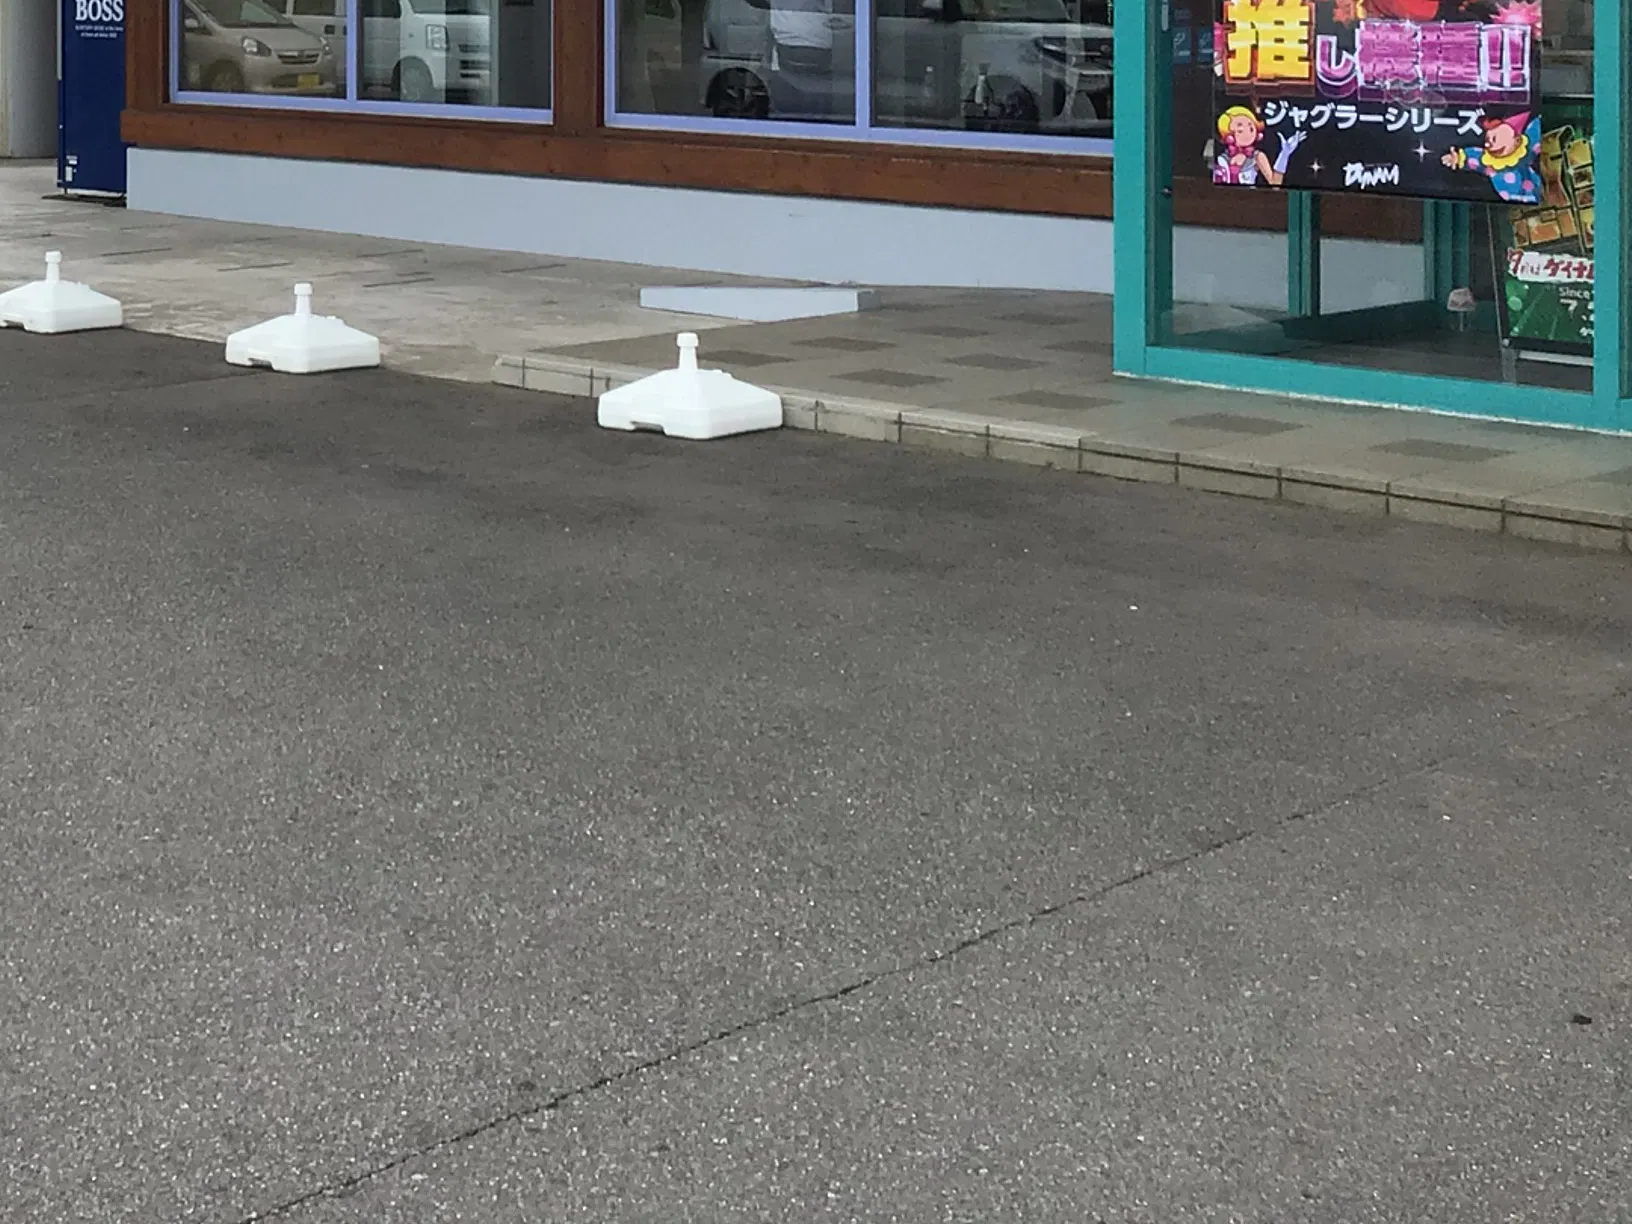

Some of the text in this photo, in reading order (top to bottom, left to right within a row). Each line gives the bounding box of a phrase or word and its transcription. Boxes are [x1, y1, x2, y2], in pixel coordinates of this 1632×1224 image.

[1264, 100, 1487, 136] ジャグラーシリーズ
[1558, 285, 1591, 300] Since
